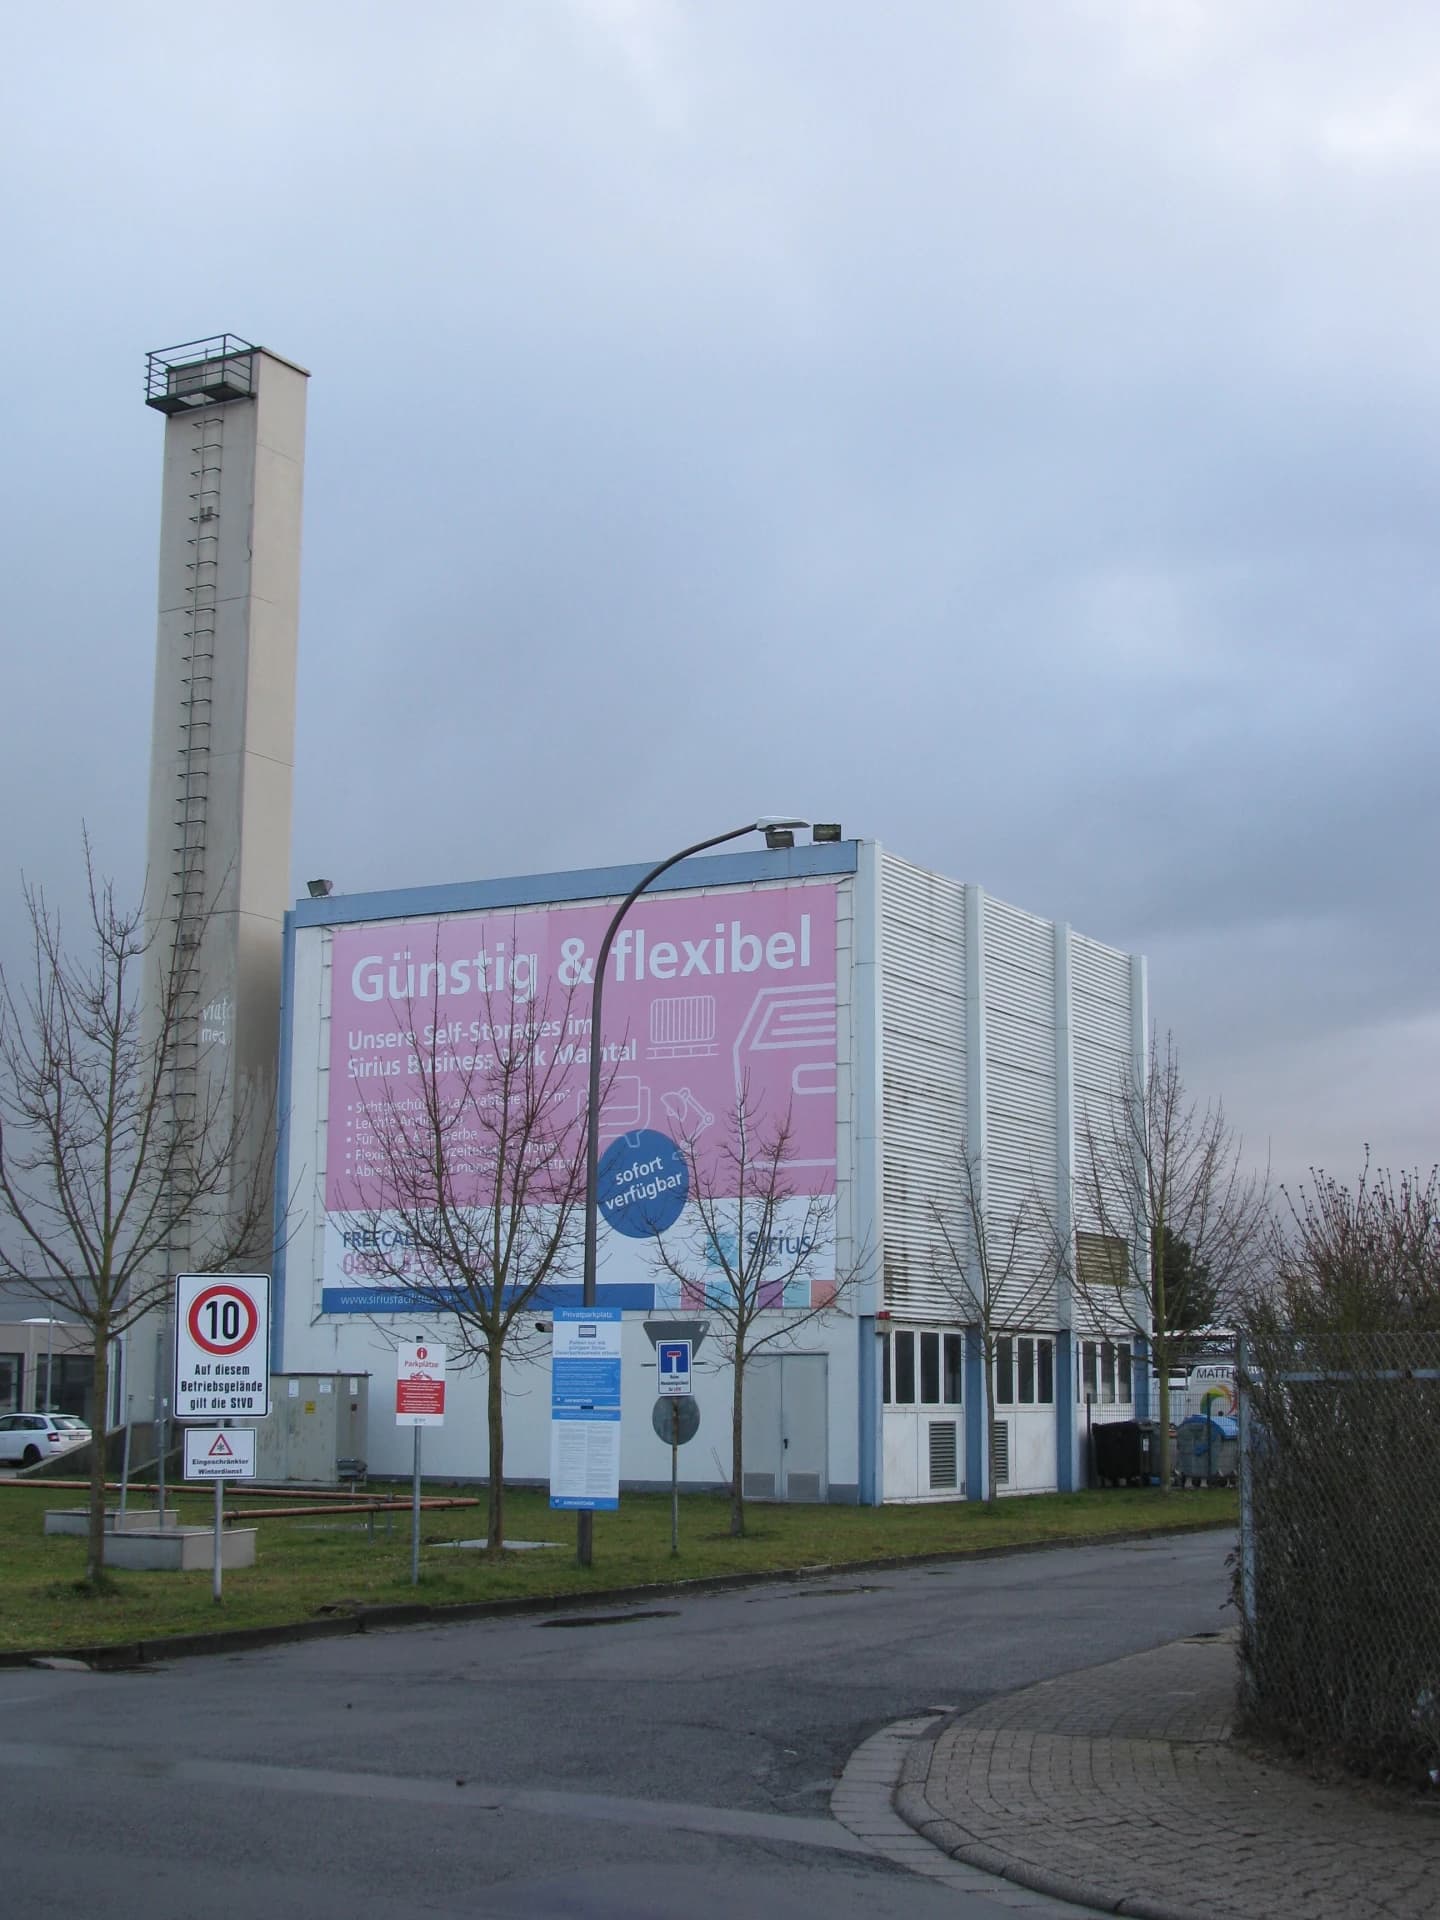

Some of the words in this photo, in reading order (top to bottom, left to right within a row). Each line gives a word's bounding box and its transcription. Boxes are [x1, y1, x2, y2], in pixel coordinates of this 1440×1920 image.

[351, 942, 538, 1004] Günstig
[557, 936, 594, 986] &
[609, 913, 813, 982] flexibel
[347, 1030, 417, 1051] Unsere
[423, 1019, 562, 1046] Self-Storages
[568, 1013, 593, 1036] im
[346, 1055, 402, 1079] Sirius
[407, 1051, 494, 1075] Business
[615, 1156, 664, 1186] sofort
[605, 1172, 683, 1211] verfügbar
[343, 1230, 421, 1248] FREECAL
[205, 1300, 240, 1340] 10
[562, 1310, 613, 1320] Privatparkplatz
[195, 1363, 211, 1375] Auf
[215, 1364, 250, 1375] diesem
[181, 1380, 263, 1394] Betriebsgelände
[190, 1397, 207, 1410] gilt
[211, 1398, 226, 1409] die
[192, 1458, 249, 1467] Eingeschränkter
